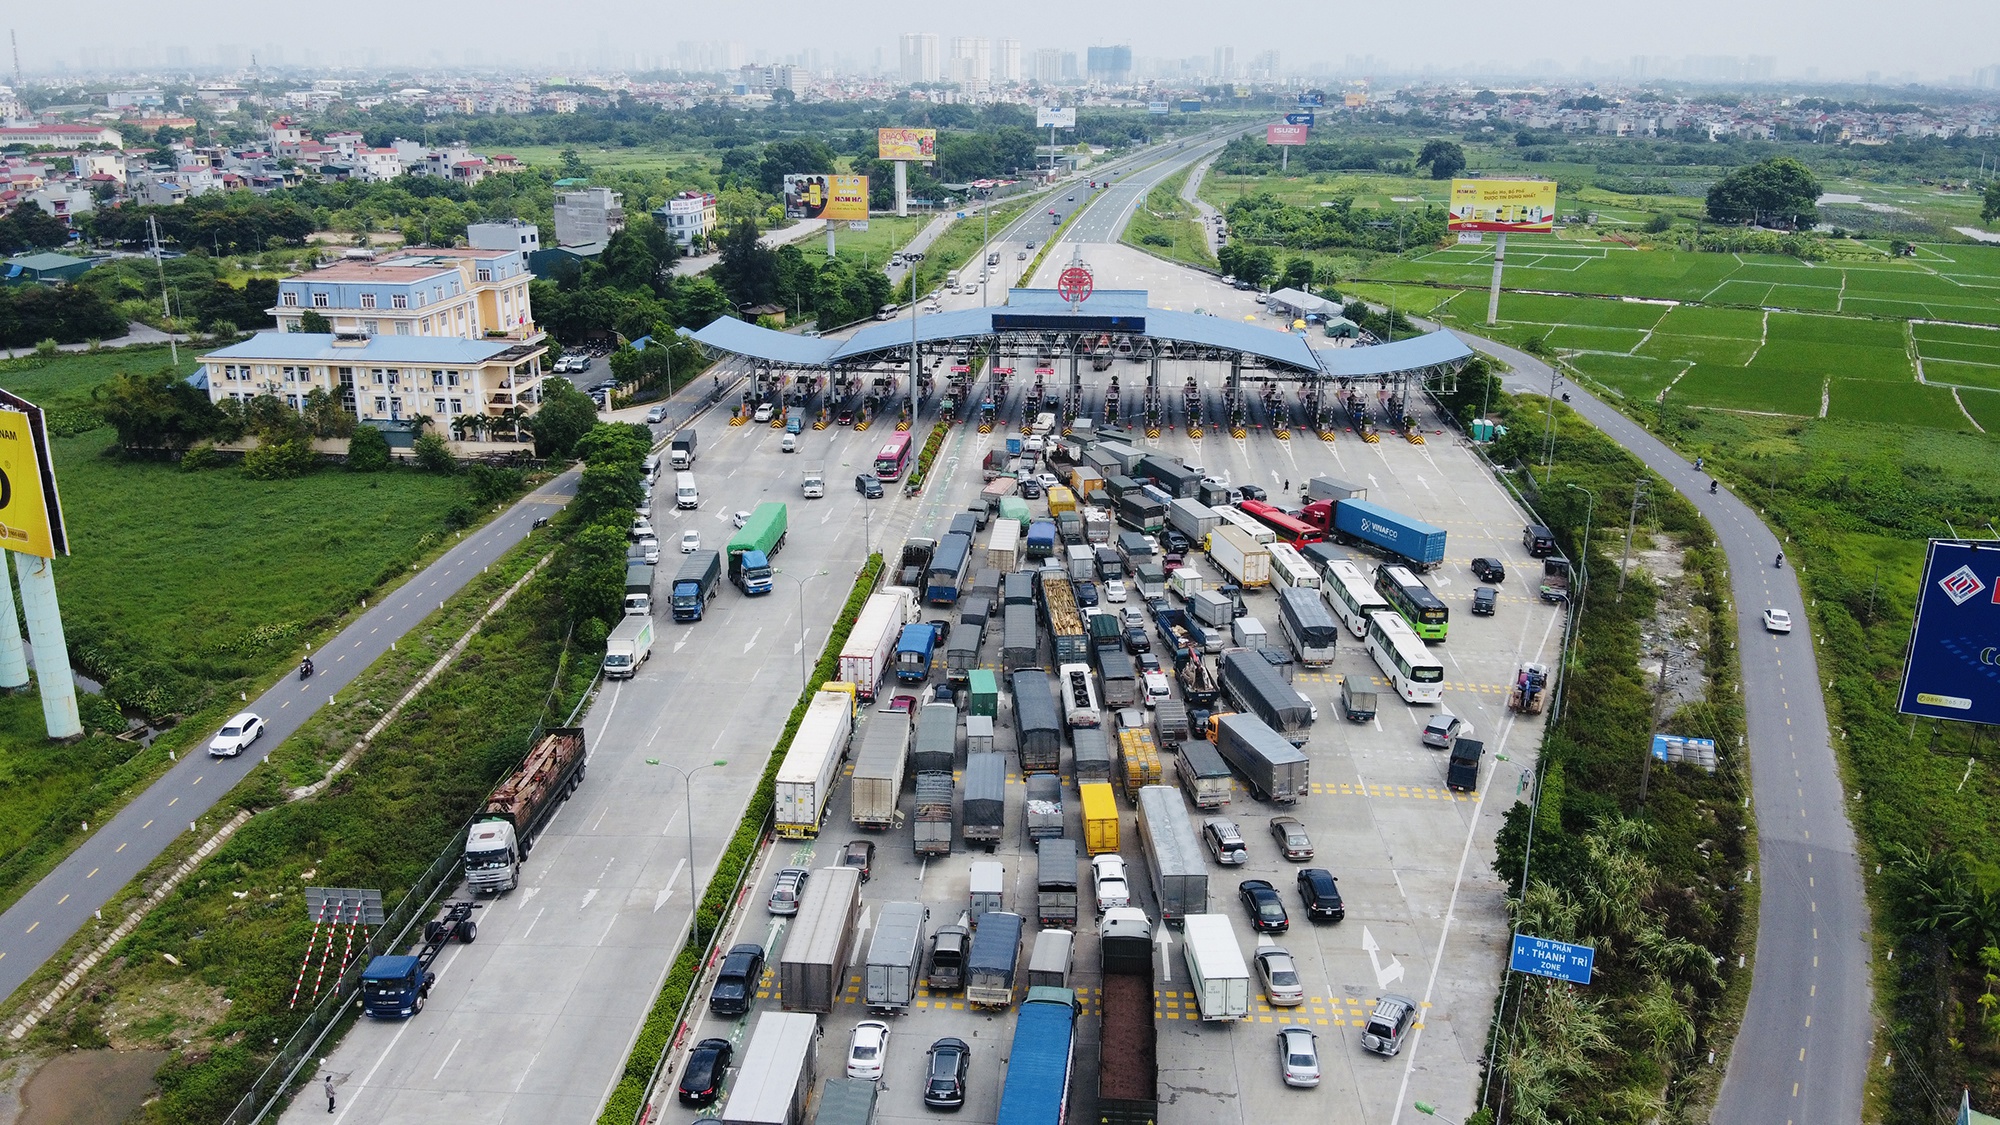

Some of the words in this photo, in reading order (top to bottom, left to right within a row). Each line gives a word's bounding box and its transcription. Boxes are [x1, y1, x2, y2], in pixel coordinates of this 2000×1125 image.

[1371, 522, 1398, 538] VINAFCO
[1536, 941, 1549, 950] ĐỊA
[1552, 943, 1572, 953] PHẬN
[1540, 961, 1561, 971] ZONE
[1571, 956, 1588, 967] TRÌ
